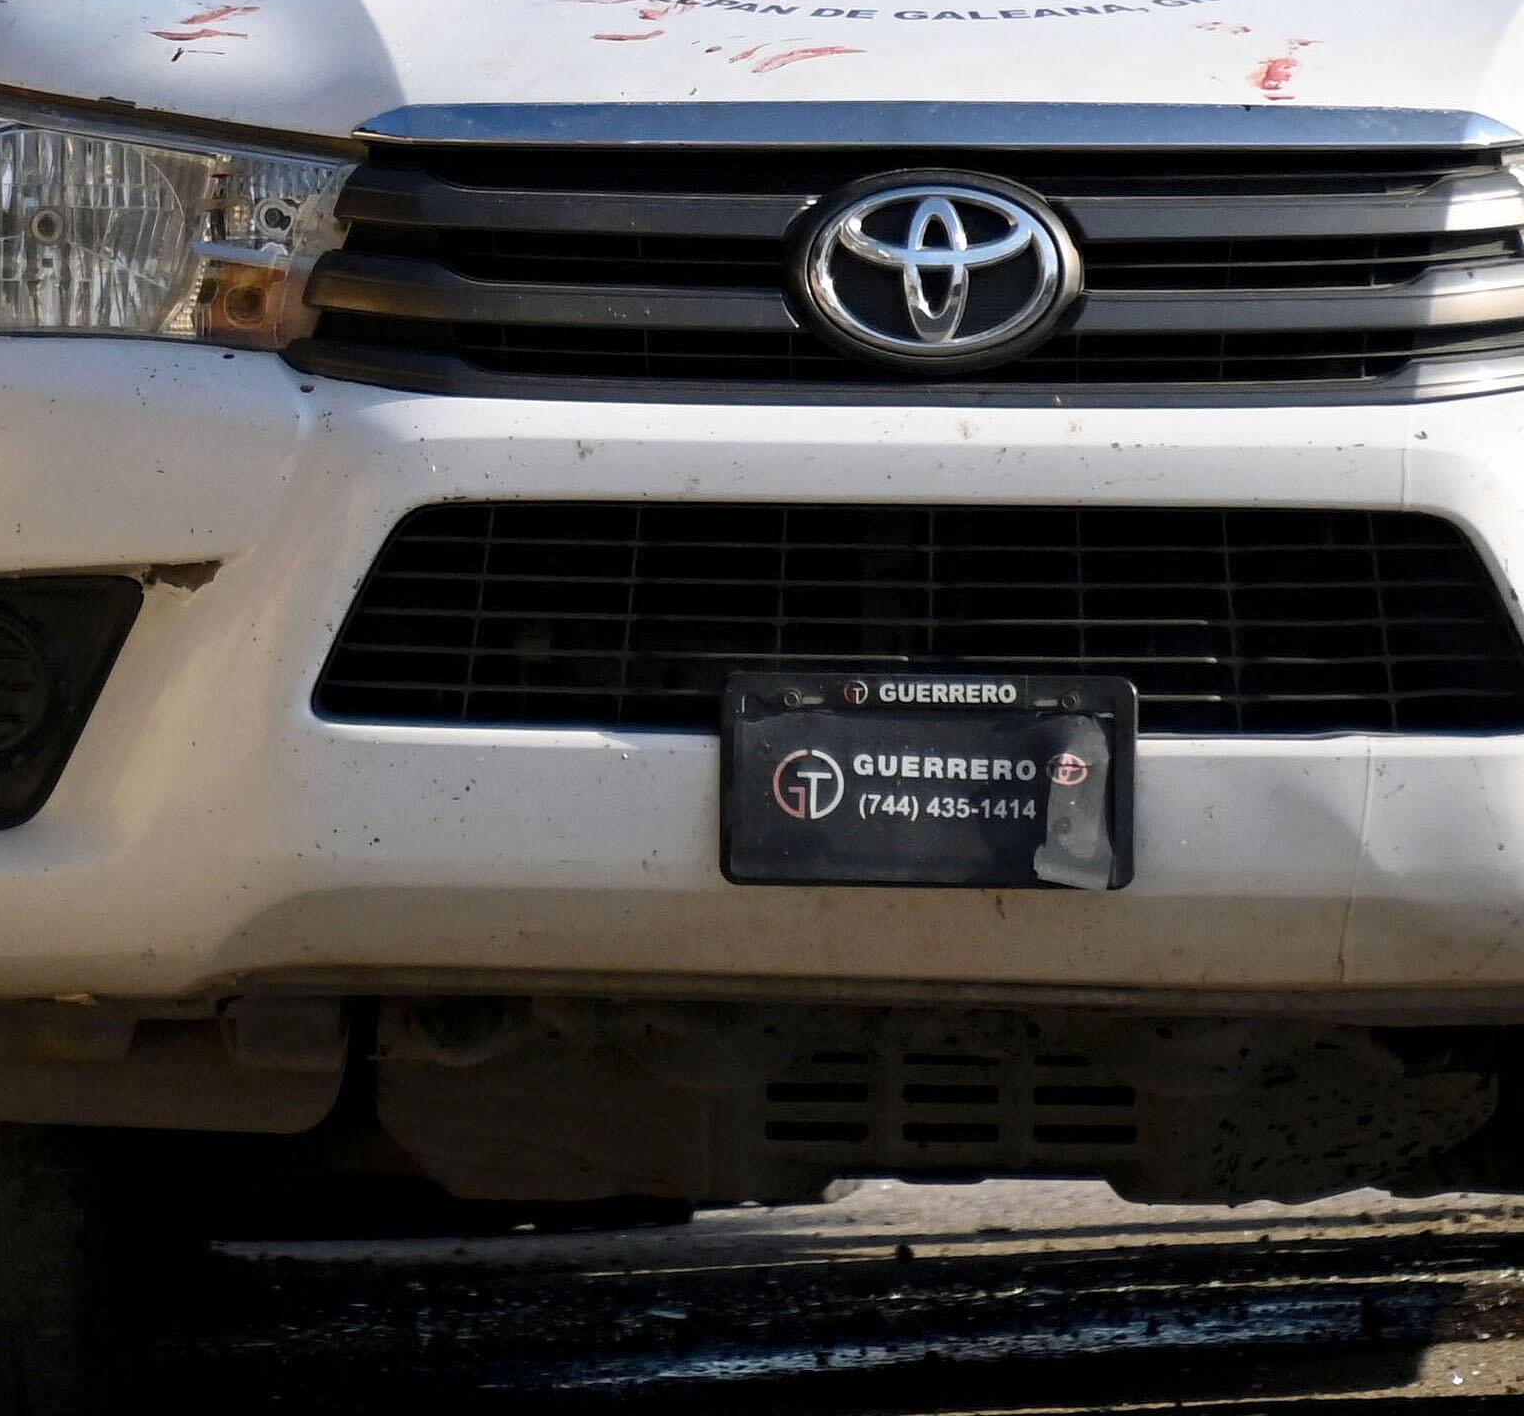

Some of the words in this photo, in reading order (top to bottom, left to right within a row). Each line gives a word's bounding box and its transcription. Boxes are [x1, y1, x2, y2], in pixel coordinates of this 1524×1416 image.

[810, 8, 879, 20] DE
[893, 4, 1150, 21] GALEANA,
[879, 683, 1018, 705] GUERRERO
[852, 753, 1037, 782] GUERRERO
[859, 793, 919, 822] (744)
[926, 794, 1037, 820] 435-1414
